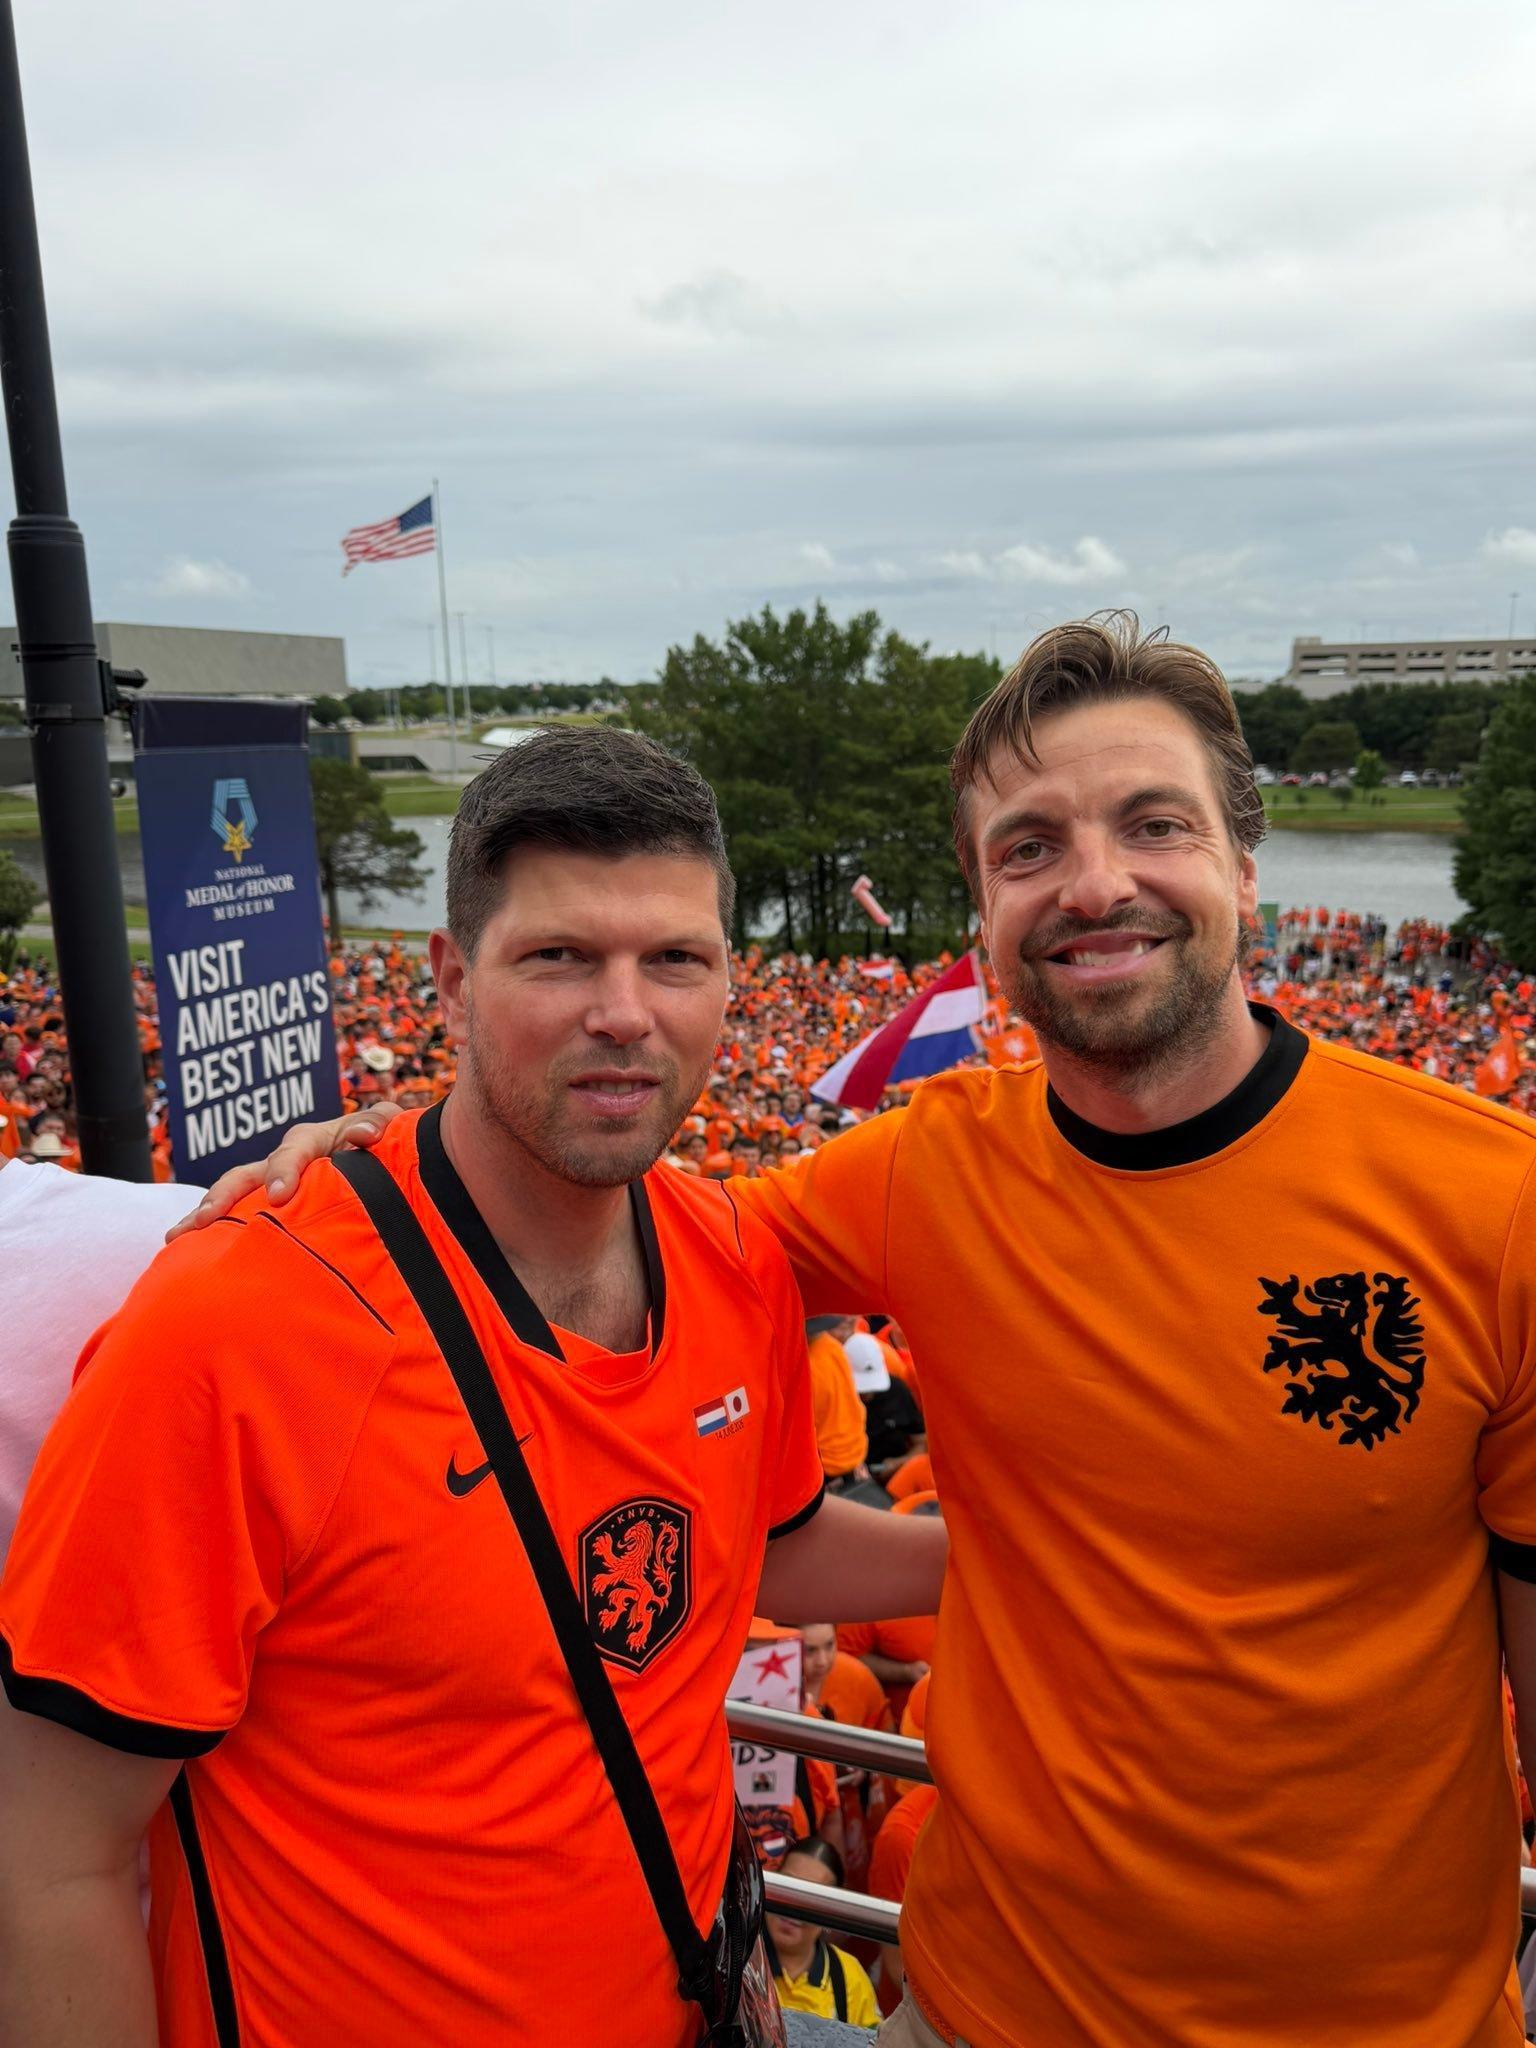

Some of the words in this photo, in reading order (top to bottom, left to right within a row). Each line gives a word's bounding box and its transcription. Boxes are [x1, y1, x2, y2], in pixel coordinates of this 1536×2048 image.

[214, 864, 265, 881] NATIONAL
[185, 882, 237, 907] MEDAL
[245, 874, 296, 897] HONOR
[212, 897, 275, 921] MUSEUM
[167, 939, 245, 1000] VISIT
[177, 970, 329, 1056] AMERICA'S
[180, 1040, 255, 1109] BEST
[261, 1019, 321, 1079] NEW
[185, 1071, 315, 1161] MUSEUM
[617, 1506, 655, 1524] KNVB
[731, 1743, 775, 1765] DS
